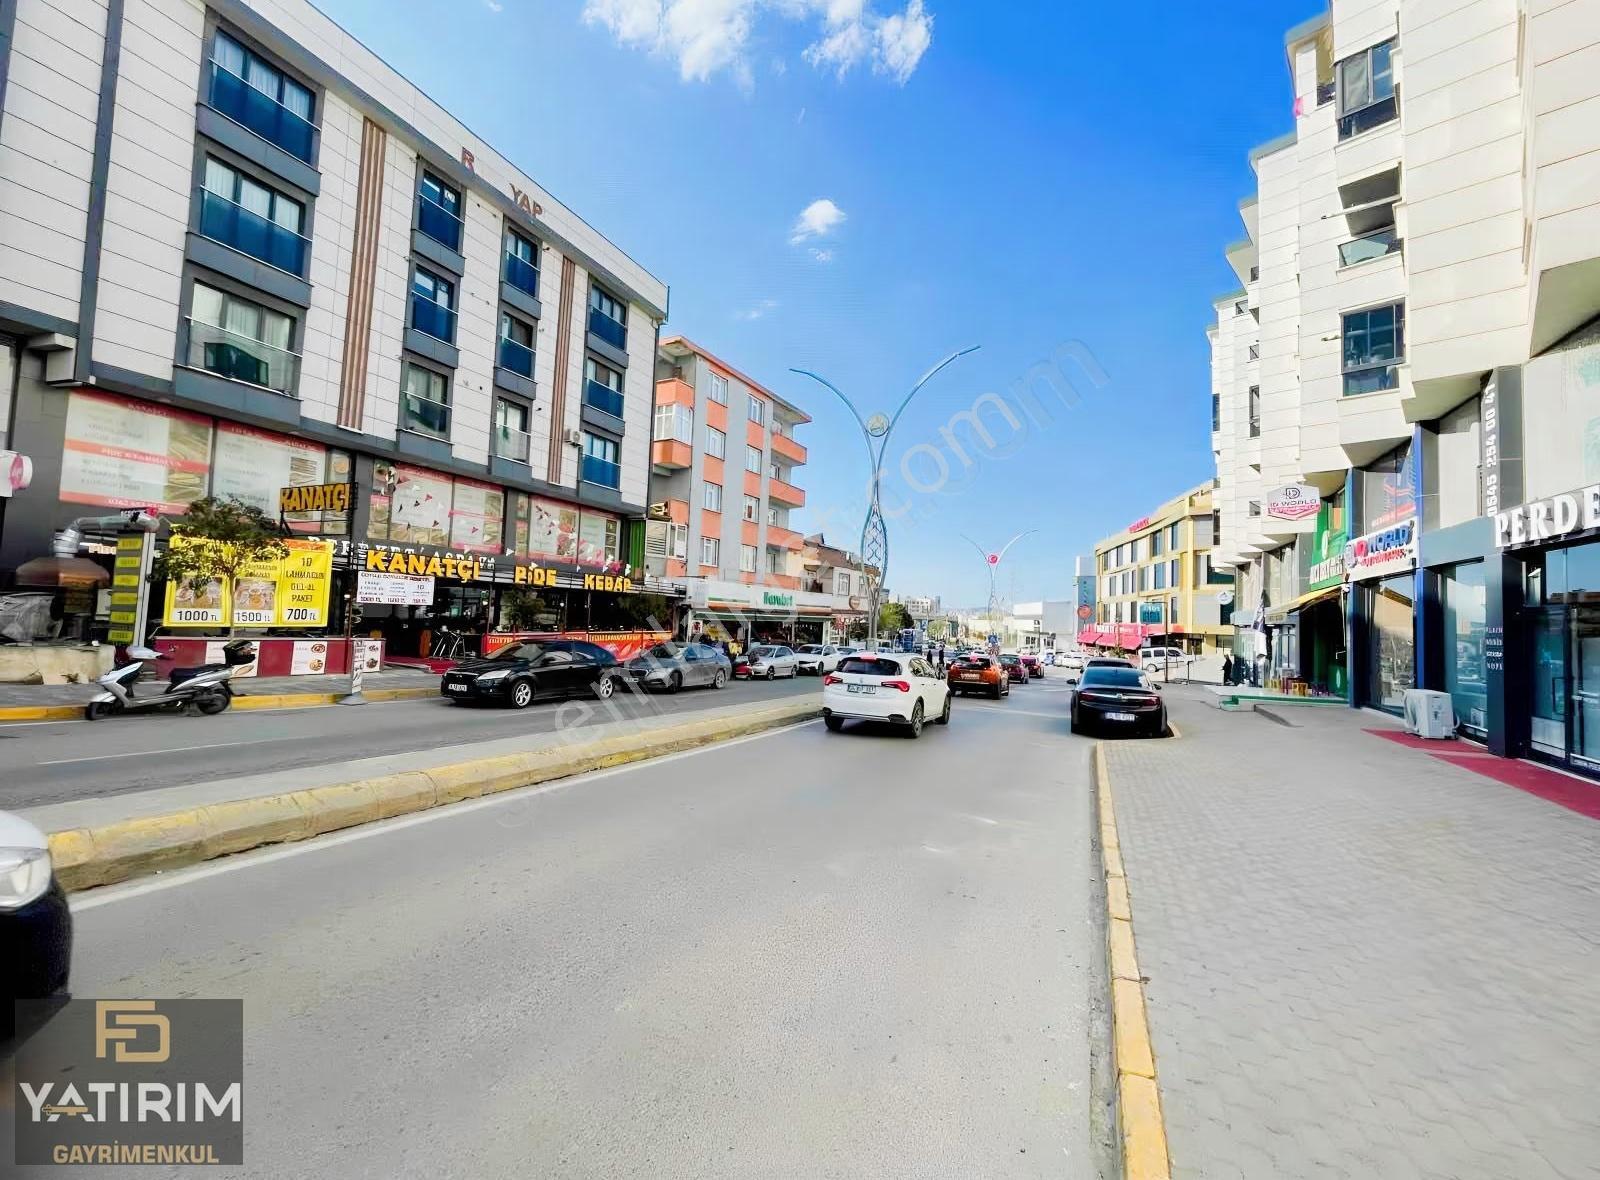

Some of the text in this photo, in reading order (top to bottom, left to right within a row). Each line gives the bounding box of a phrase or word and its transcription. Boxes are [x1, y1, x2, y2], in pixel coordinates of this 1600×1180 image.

[1484, 383, 1496, 404] 41
[1485, 407, 1496, 432] 00
[280, 484, 351, 513] KANATÇI
[1486, 474, 1498, 517] 0545
[1494, 484, 1600, 548] PERDE
[366, 549, 481, 583] KANATÇI
[583, 573, 632, 592] KEBAP
[177, 610, 209, 621] 1000
[235, 612, 262, 622] 1500
[287, 608, 307, 620] 700
